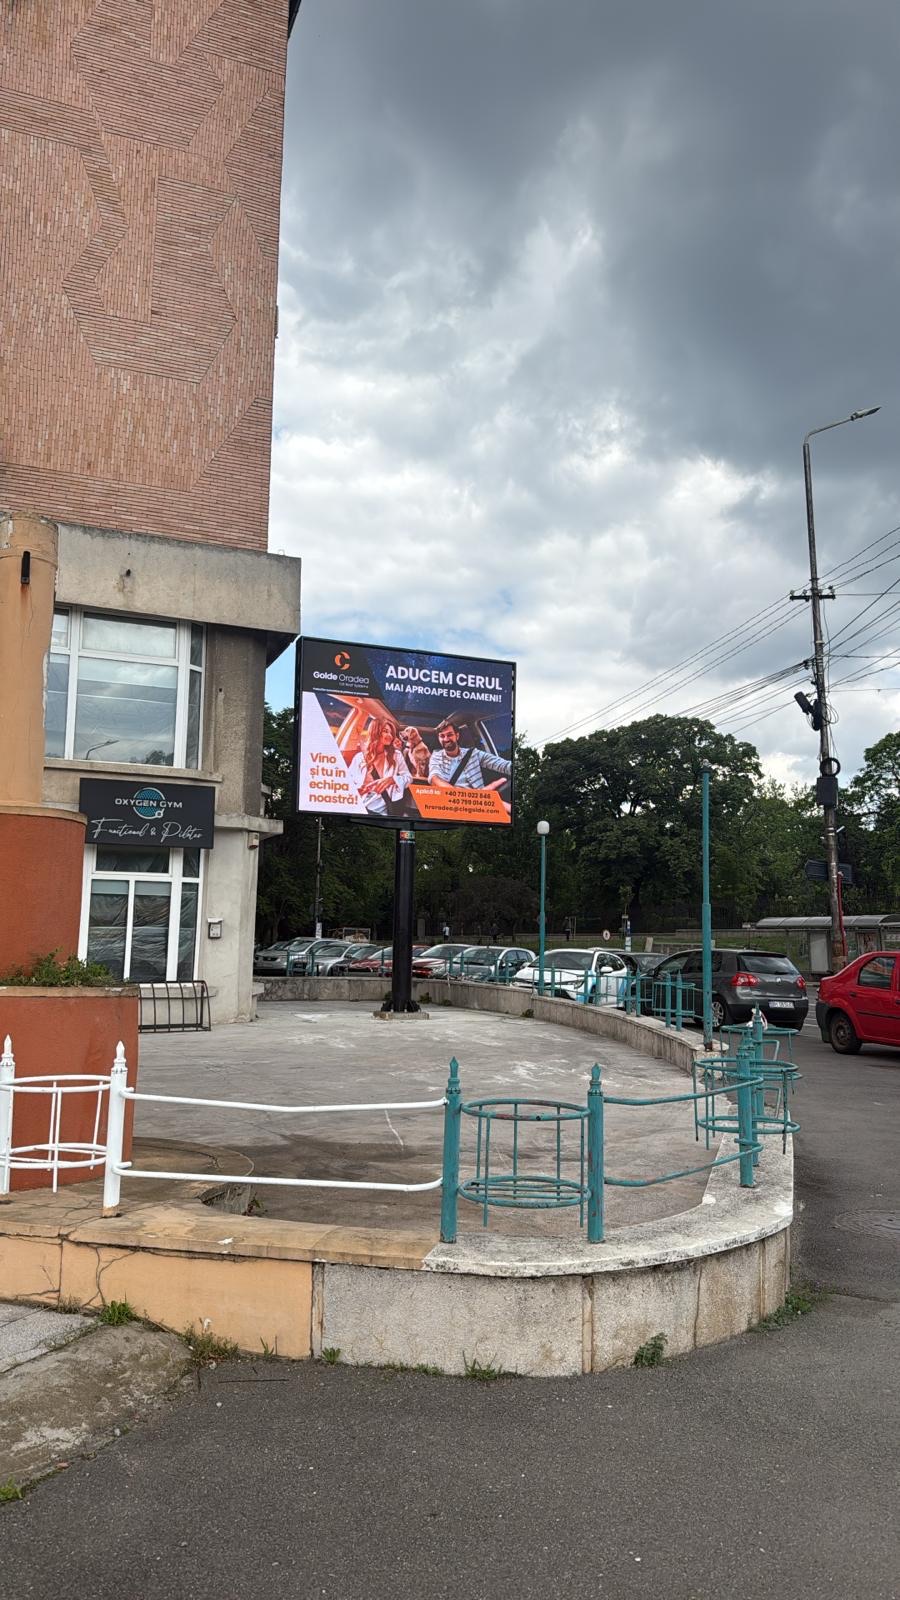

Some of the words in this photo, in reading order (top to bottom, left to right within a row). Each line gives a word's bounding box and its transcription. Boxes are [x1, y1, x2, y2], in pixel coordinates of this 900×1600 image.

[339, 674, 369, 684] Oradea
[385, 665, 453, 685] ADUCEM
[456, 673, 503, 690] CERUL
[385, 682, 404, 692] MAI
[405, 684, 448, 697] APROAPE
[450, 690, 462, 699] DE
[463, 691, 502, 703] OAMENI!
[310, 752, 336, 764] Vino
[310, 765, 319, 779] și
[321, 767, 333, 777] tu
[334, 767, 346, 778] în
[309, 780, 349, 793] echipa
[115, 798, 157, 807] OXYGEN
[159, 801, 183, 809] GYM
[309, 794, 358, 805] noastră!
[150, 827, 157, 836] &
